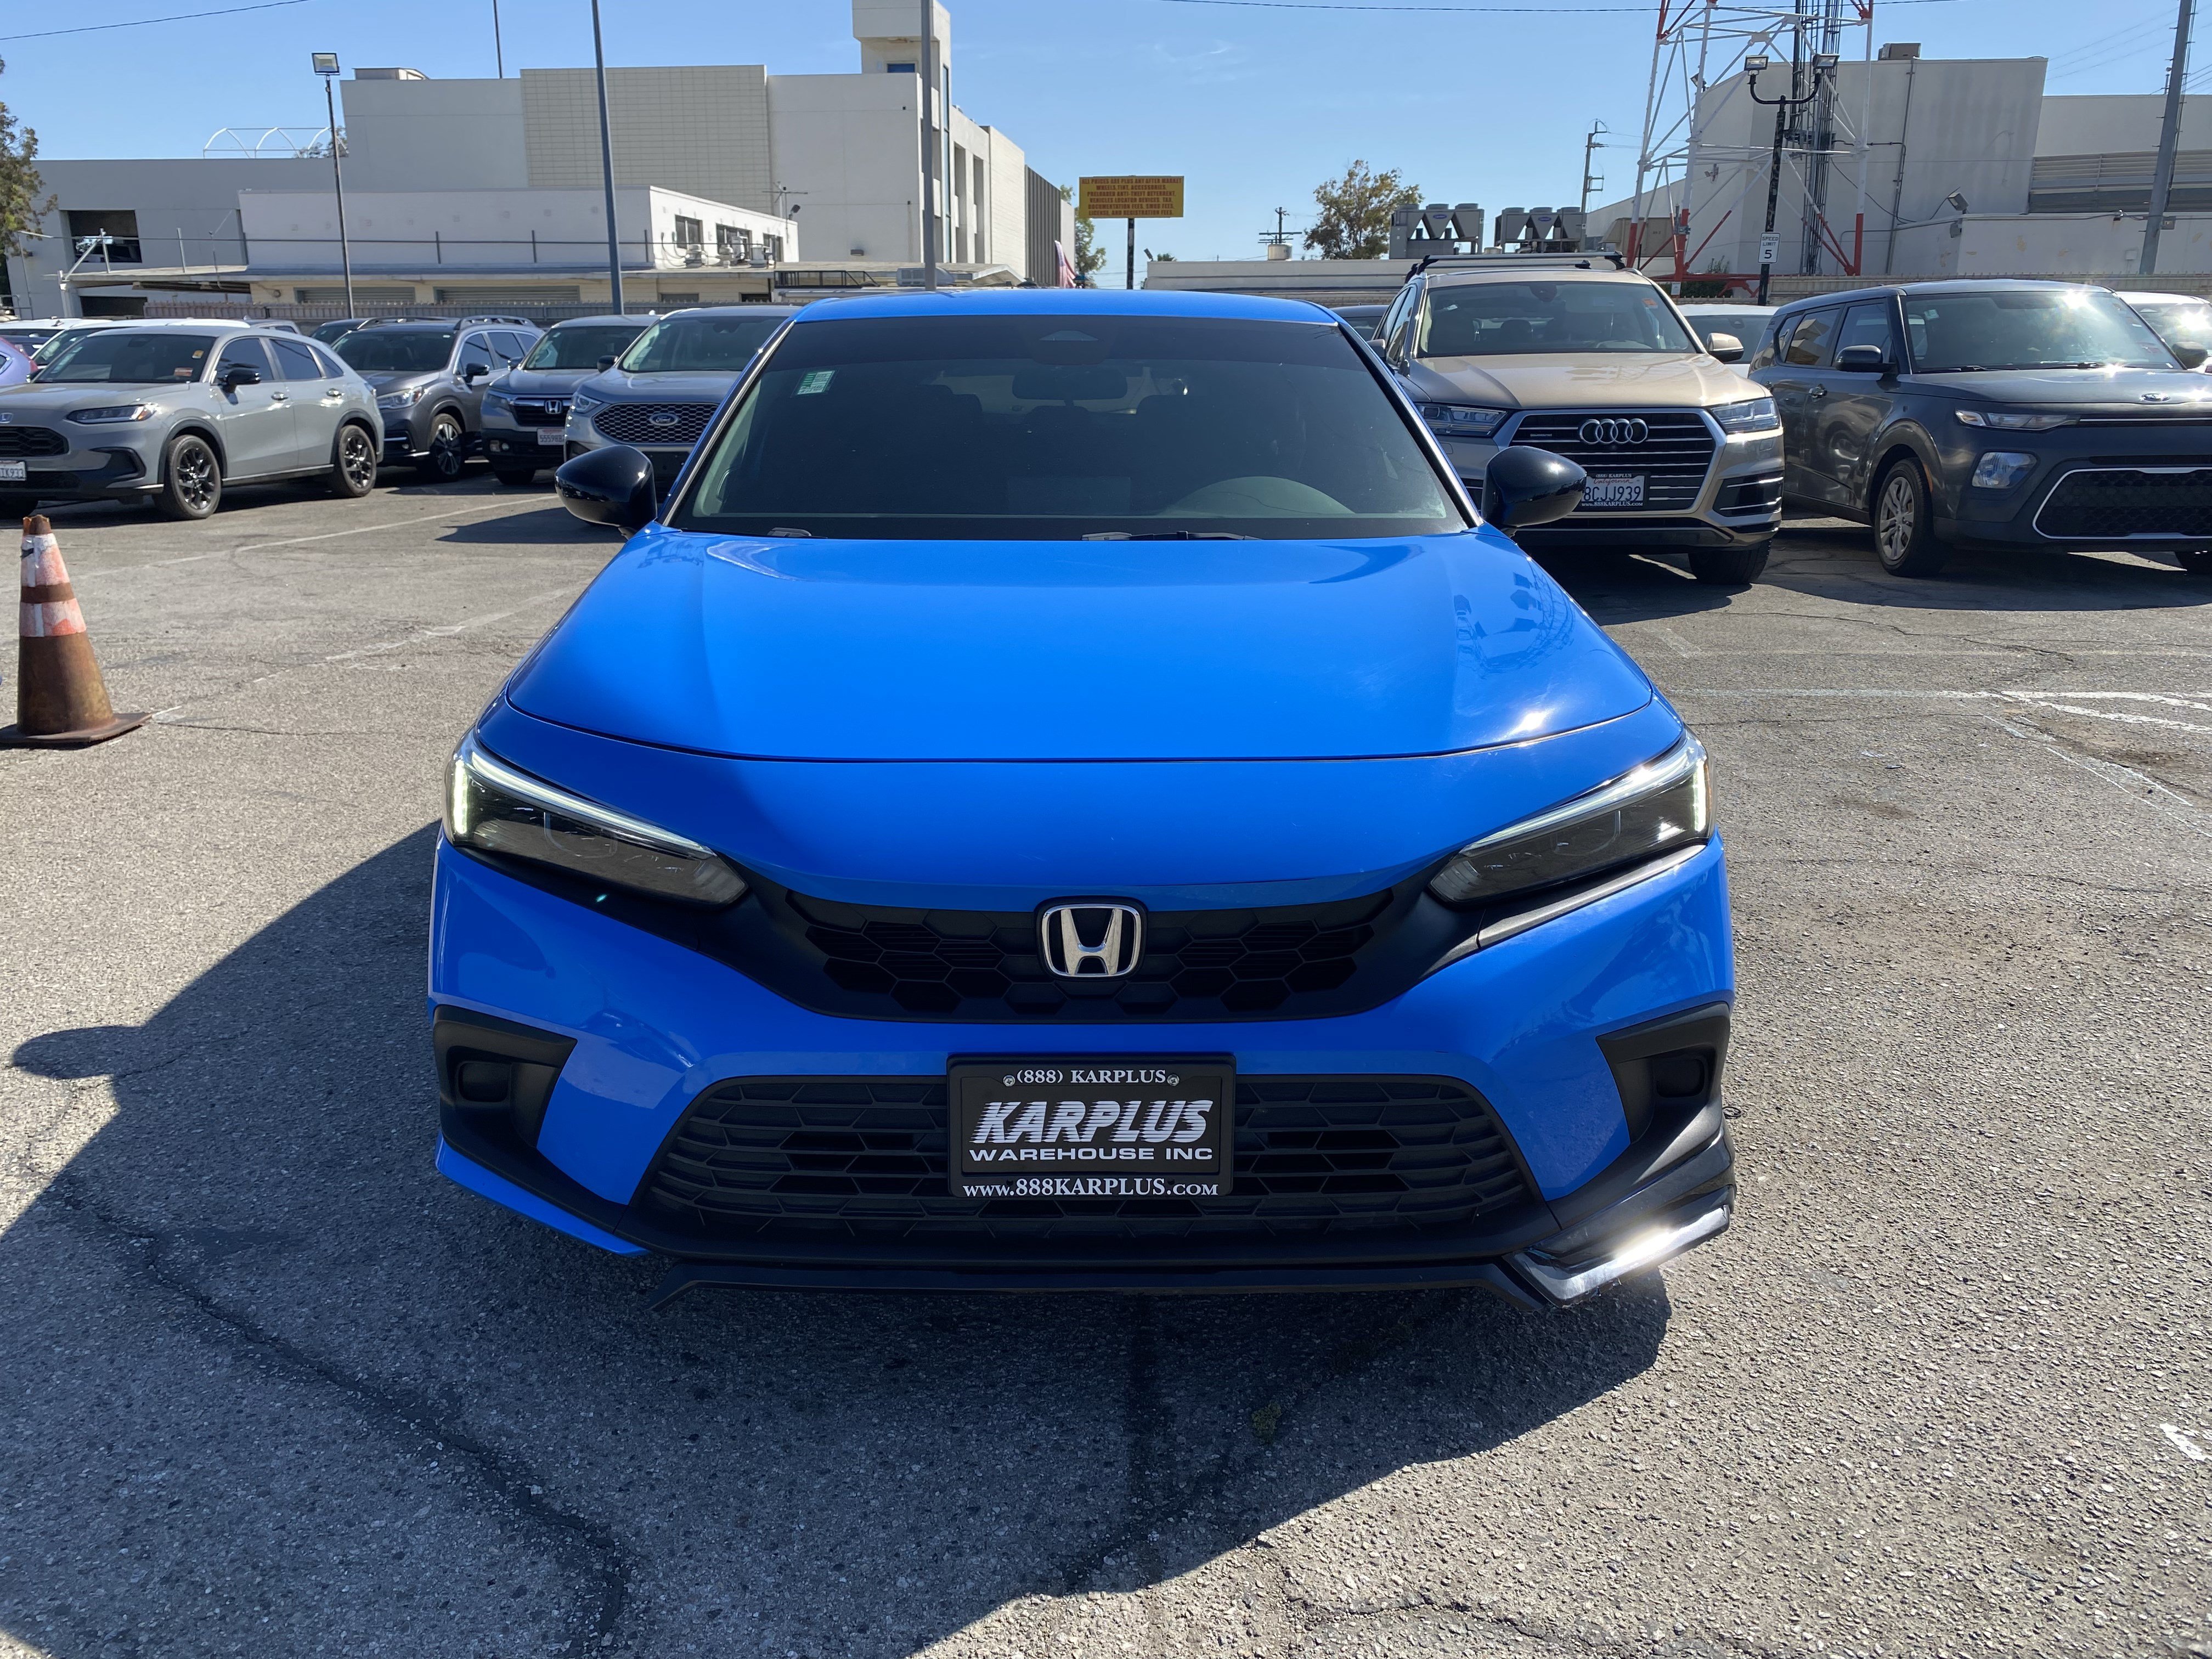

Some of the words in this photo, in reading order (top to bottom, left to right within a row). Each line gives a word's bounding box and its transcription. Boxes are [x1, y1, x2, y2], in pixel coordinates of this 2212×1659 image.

[1764, 249, 1772, 259] 5
[1583, 486, 1641, 501] 8CJJ939
[1017, 1069, 1064, 1084] (888)
[1070, 1069, 1166, 1084] KARPLUS
[969, 1100, 1214, 1143] KARPLUS
[969, 1148, 1154, 1161] WAREHOUSE
[1166, 1148, 1213, 1160] INC
